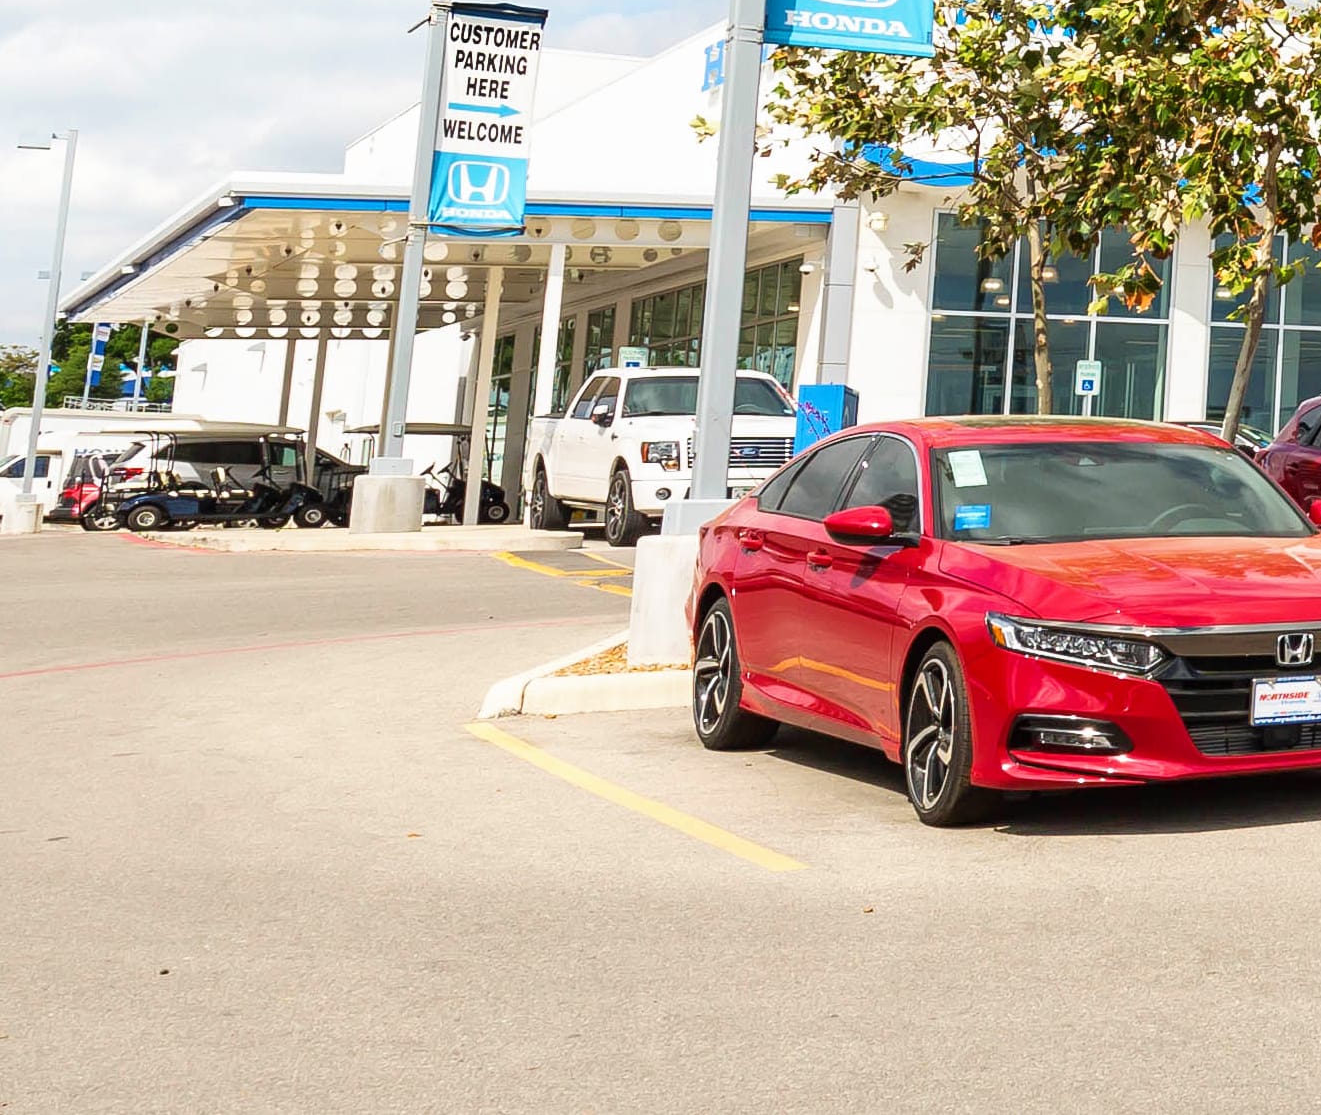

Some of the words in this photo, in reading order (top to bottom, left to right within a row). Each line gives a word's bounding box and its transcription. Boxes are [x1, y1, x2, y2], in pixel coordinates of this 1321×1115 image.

[450, 22, 541, 51] CUSTOMER
[784, 9, 912, 38] HONDA
[454, 50, 528, 75] PARKING
[466, 77, 510, 99] HERE
[443, 118, 523, 144] WELCOME
